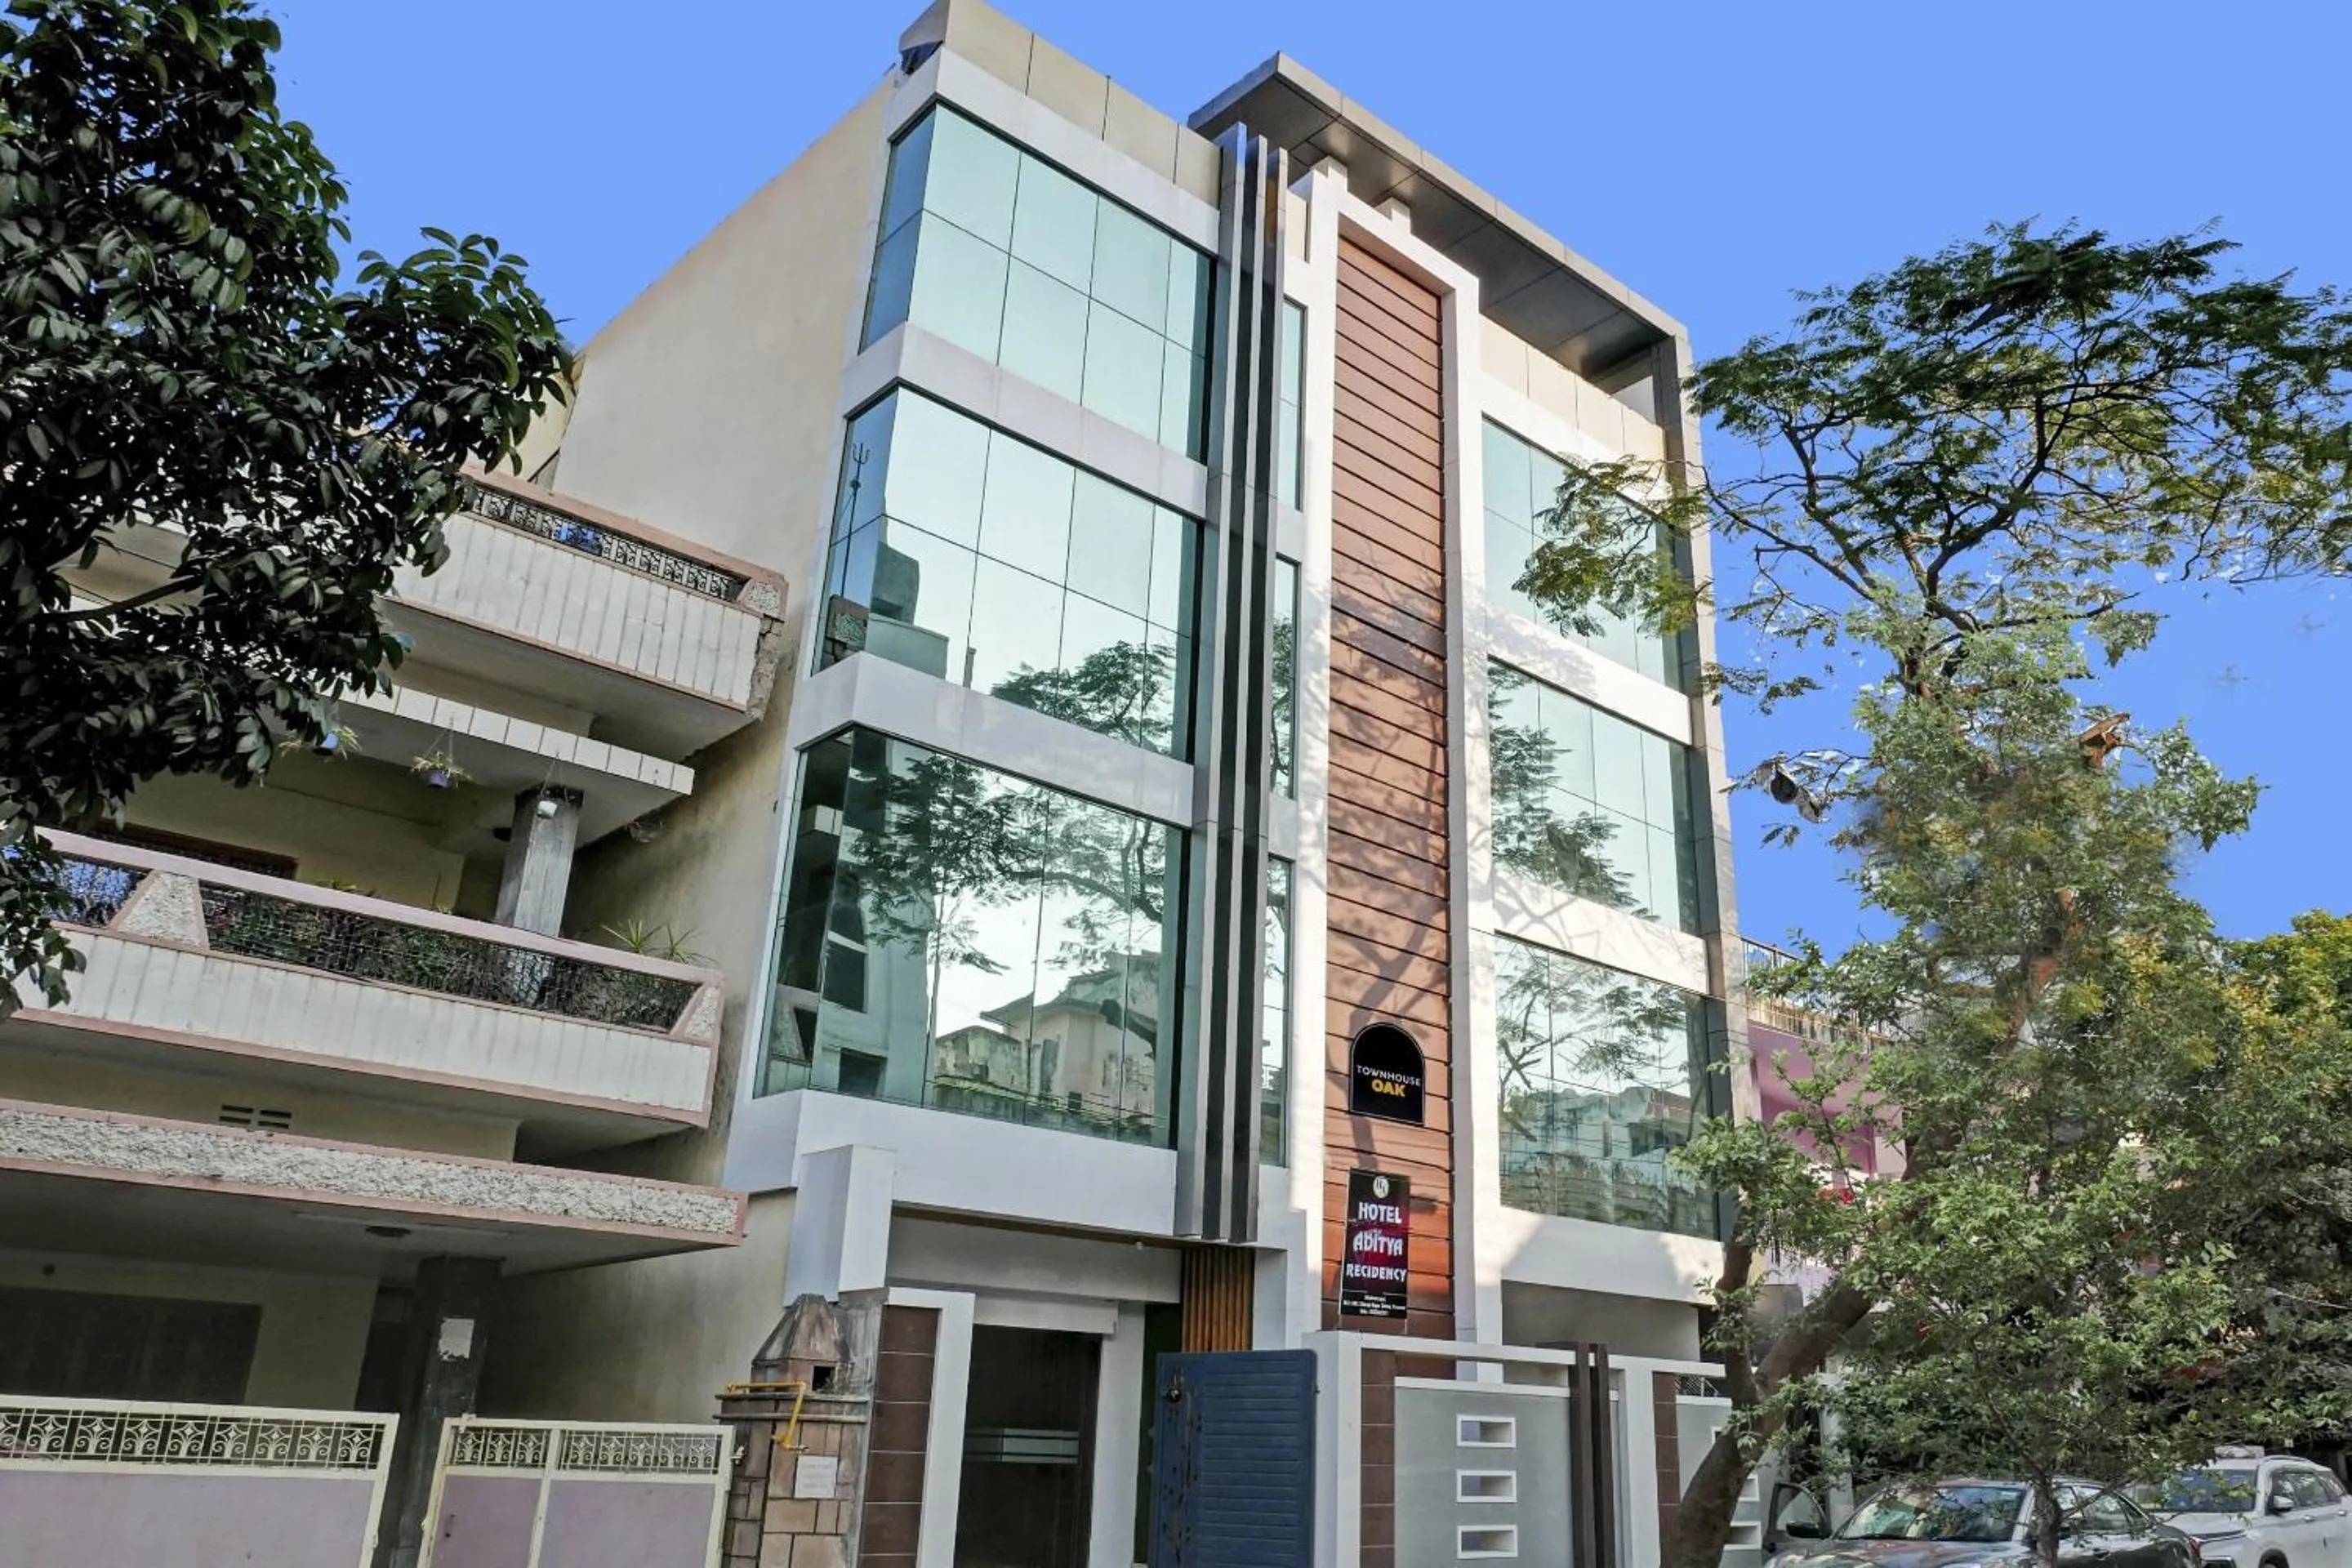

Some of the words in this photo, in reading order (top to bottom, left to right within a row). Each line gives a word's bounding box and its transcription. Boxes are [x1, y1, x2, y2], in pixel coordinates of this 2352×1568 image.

[1356, 1065, 1421, 1086] TOWNHOUSE
[1371, 1080, 1405, 1097] OAK
[1358, 1201, 1402, 1223] HOTEL
[1352, 1228, 1403, 1256] ADITYA
